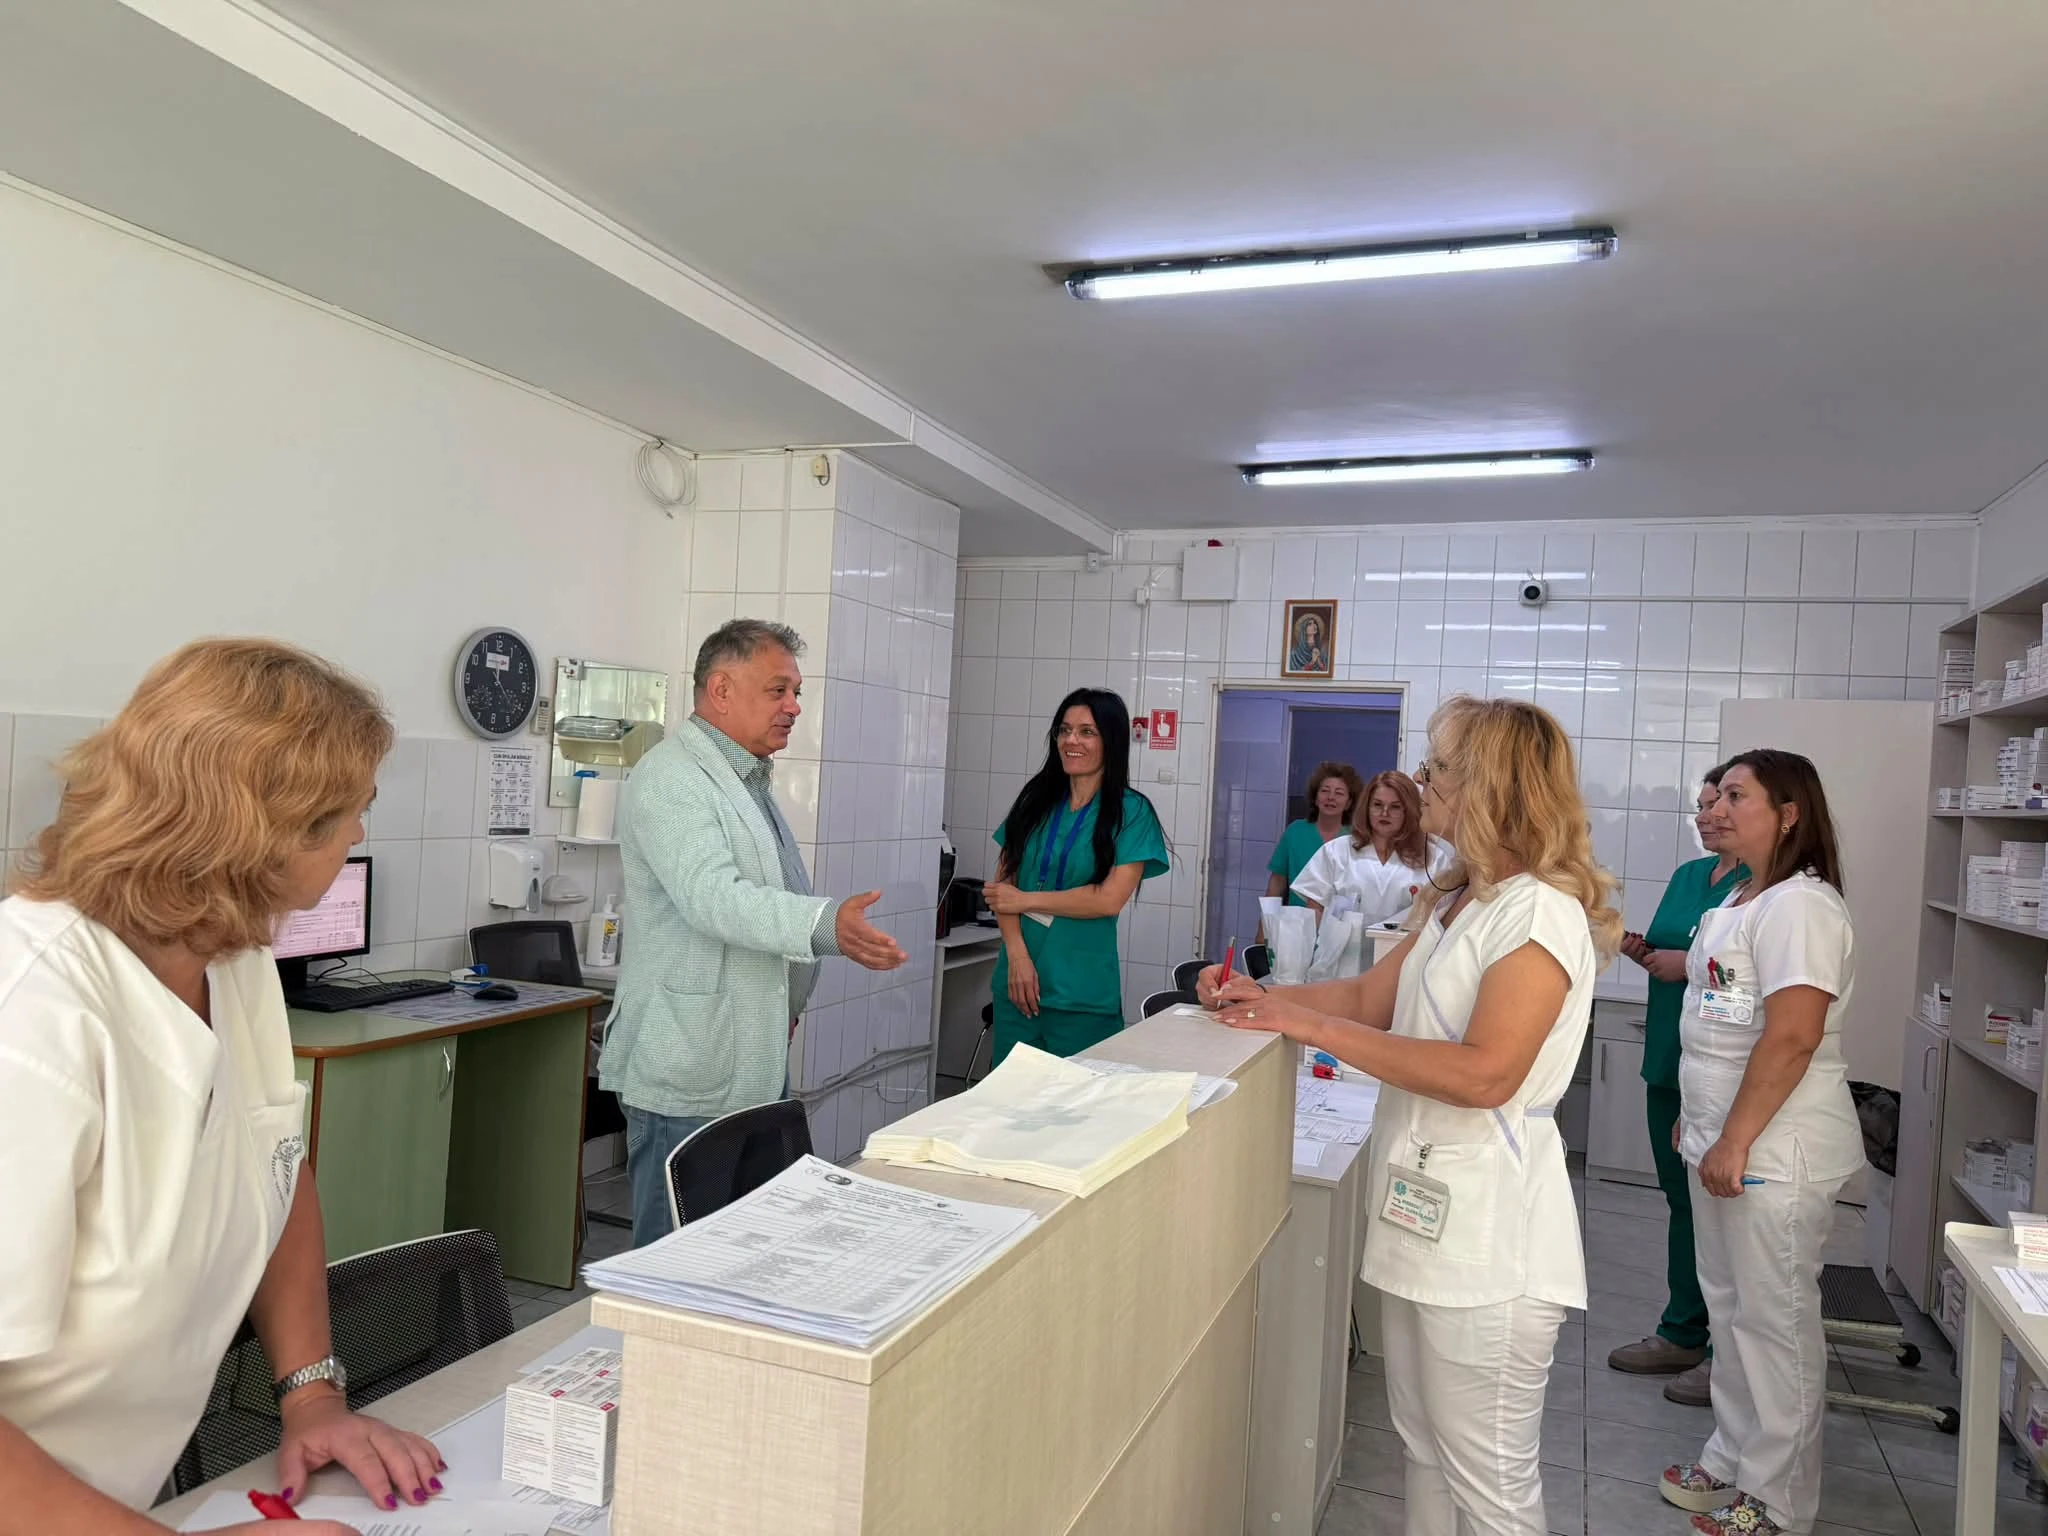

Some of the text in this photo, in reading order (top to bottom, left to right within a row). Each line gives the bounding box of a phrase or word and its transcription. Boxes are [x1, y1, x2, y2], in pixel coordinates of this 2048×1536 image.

[482, 641, 488, 653] 11
[496, 640, 504, 652] 12
[472, 654, 479, 666] 10
[518, 662, 524, 674] 2
[465, 672, 471, 684] 9
[521, 682, 527, 693] 3
